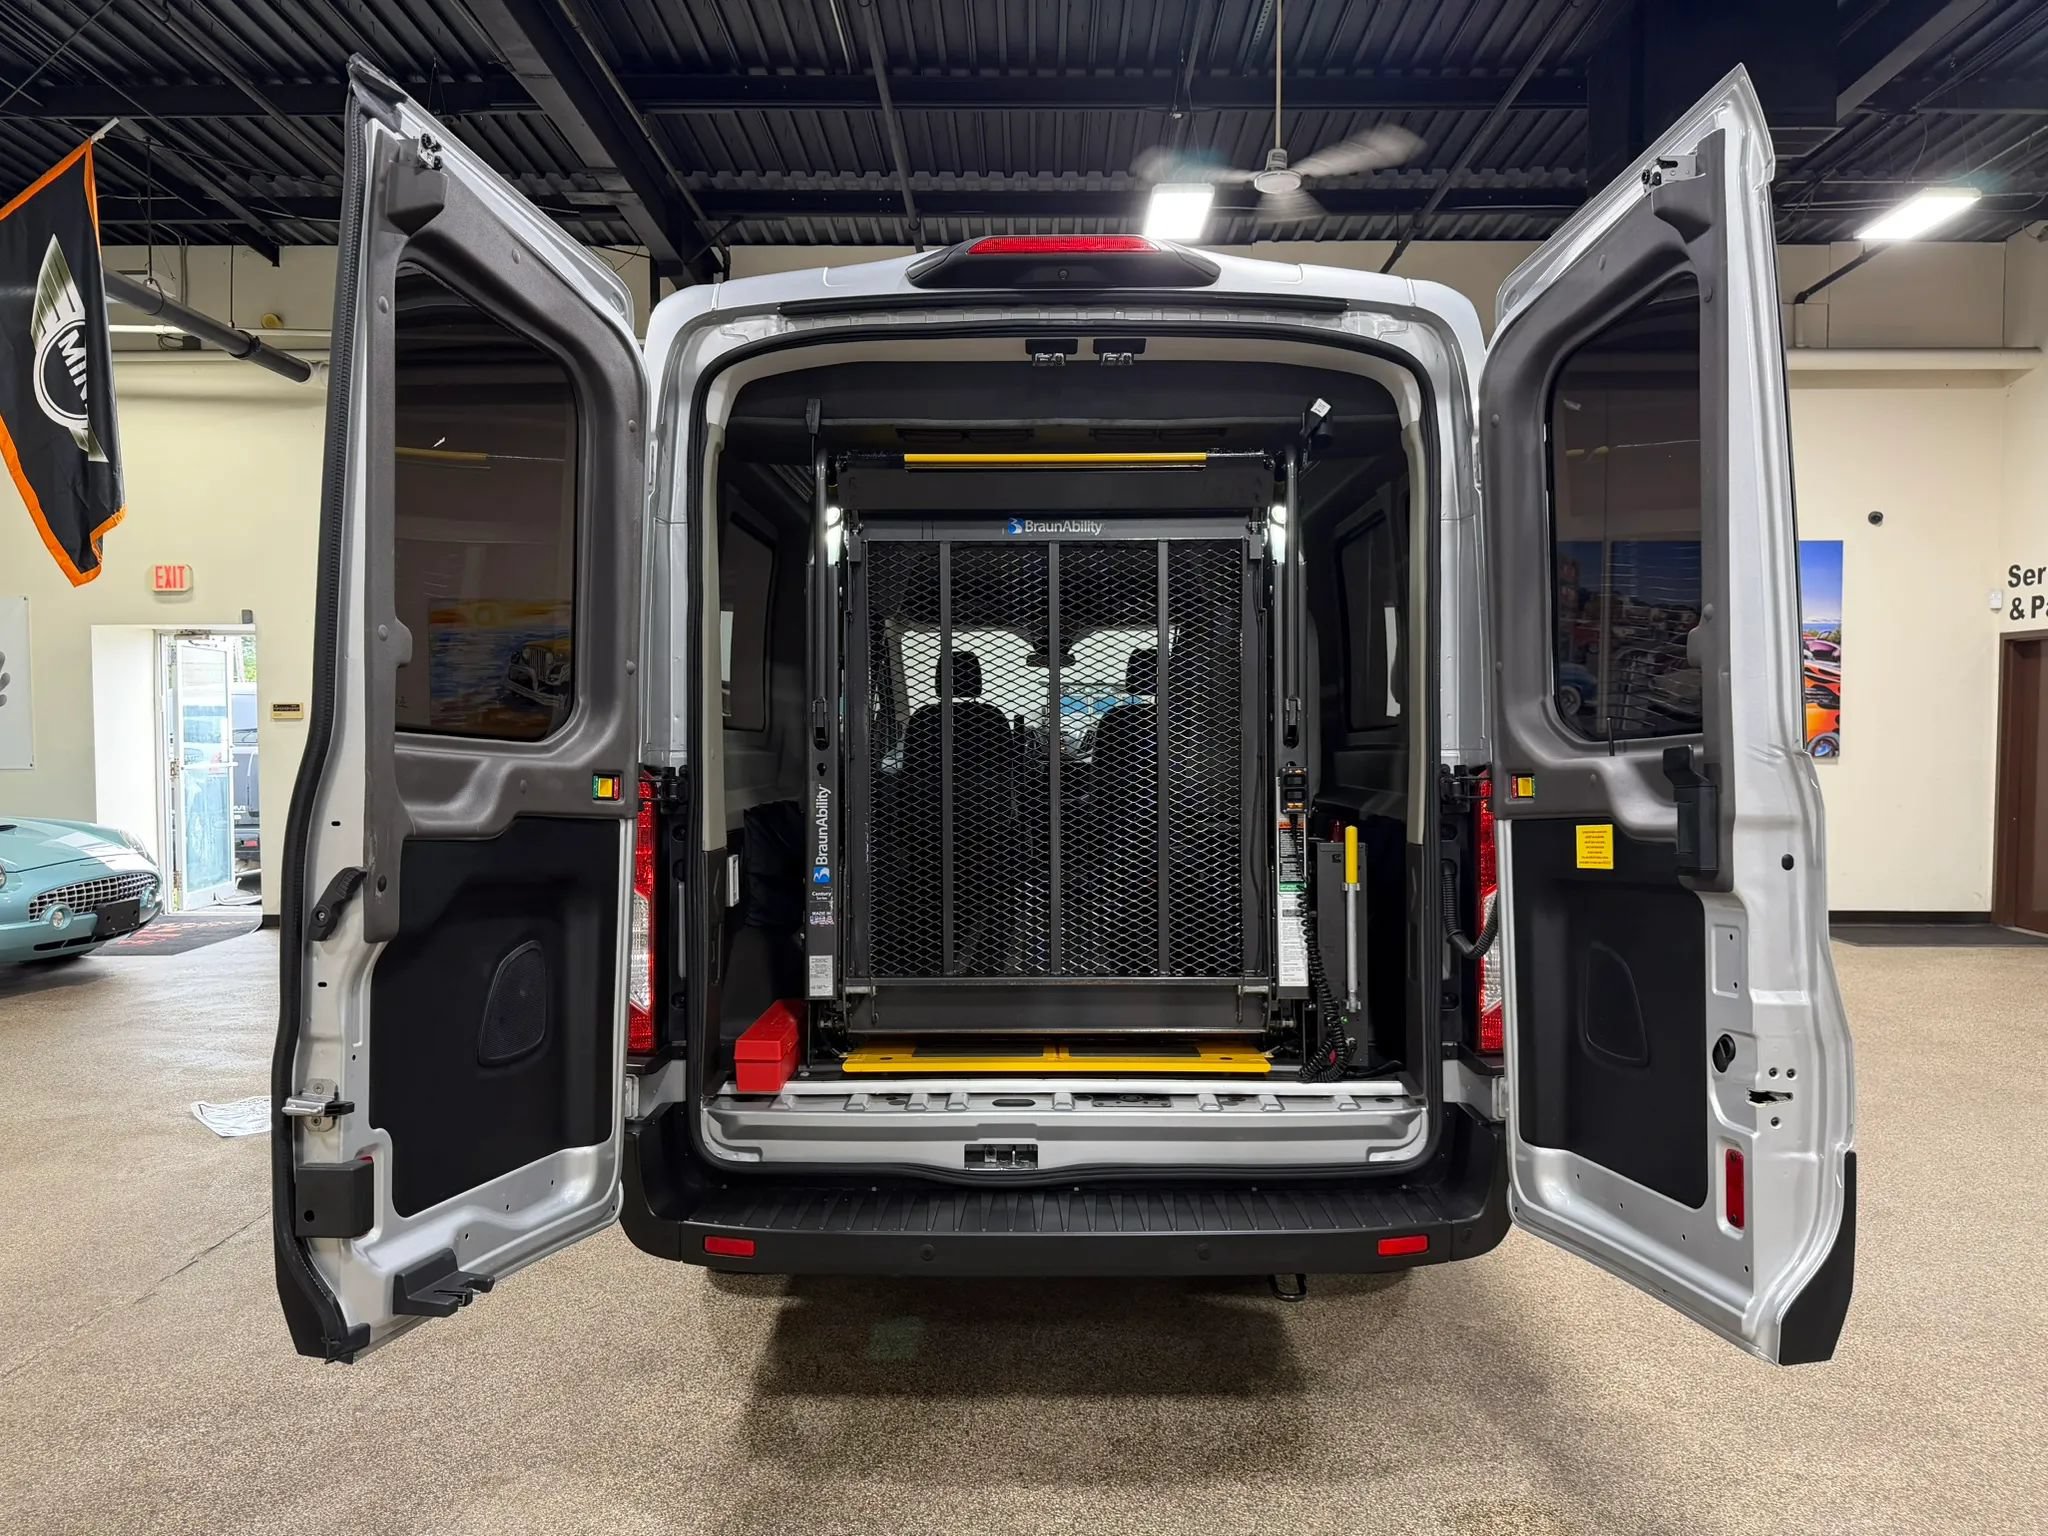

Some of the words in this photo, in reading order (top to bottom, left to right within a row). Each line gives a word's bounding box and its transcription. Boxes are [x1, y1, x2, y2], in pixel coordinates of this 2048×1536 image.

[57, 328, 88, 410] MI
[1024, 519, 1103, 536] BraunAbility
[154, 565, 186, 589] EXIT
[2007, 564, 2047, 588] Ser
[2009, 596, 2026, 621] &
[2030, 594, 2048, 619] P
[815, 783, 832, 865] BraunAbility
